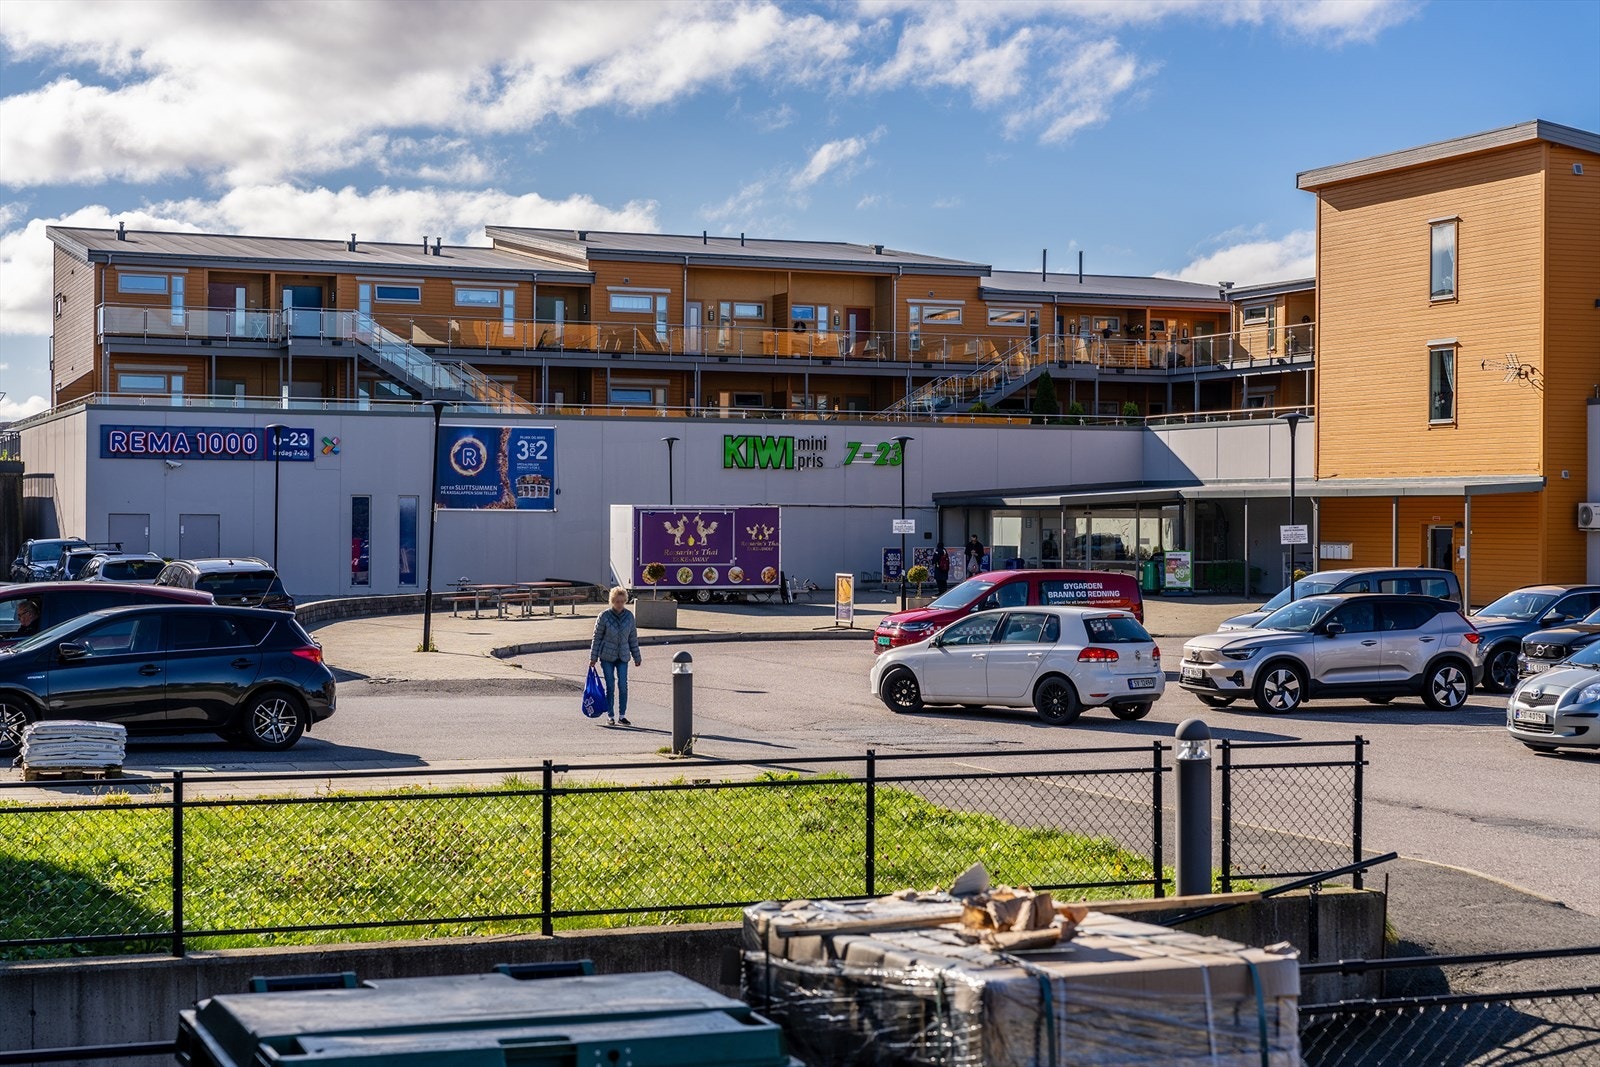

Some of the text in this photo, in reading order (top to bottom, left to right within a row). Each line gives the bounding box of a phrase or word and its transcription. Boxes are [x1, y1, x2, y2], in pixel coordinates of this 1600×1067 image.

[109, 431, 258, 454] REMA 1000
[516, 440, 529, 460] 3
[535, 441, 548, 460] 2
[273, 449, 292, 457] lrdag
[462, 448, 477, 466] R
[723, 435, 827, 469] KIWI mini
[798, 453, 824, 471] pris
[701, 547, 718, 556] Thai
[1063, 582, 1103, 590] ØYGARDEN
[1087, 590, 1120, 598] REDNING
